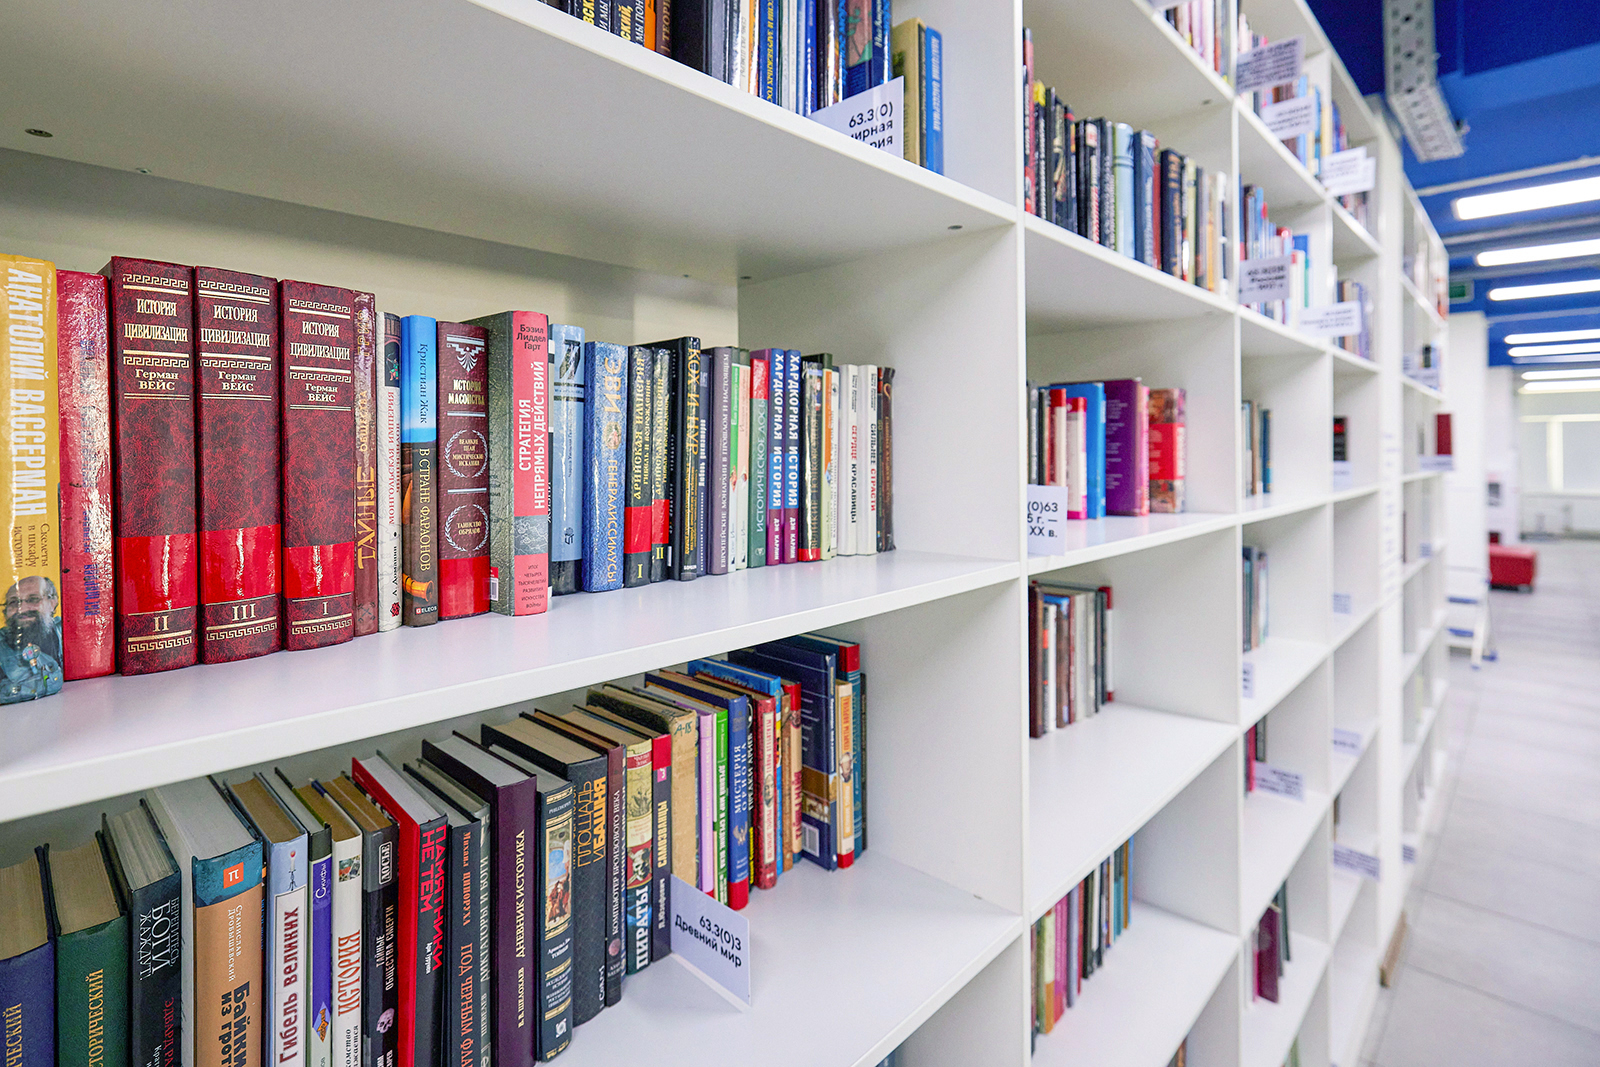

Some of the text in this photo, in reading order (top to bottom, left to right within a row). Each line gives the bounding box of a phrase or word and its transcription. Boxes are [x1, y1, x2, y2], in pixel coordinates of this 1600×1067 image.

[849, 101, 894, 128] 63.3(0)
[136, 298, 178, 317] ИСТОРИЯ
[212, 304, 258, 322] ИСТОРИЯ
[302, 320, 340, 338] ИСТОРИЯ
[520, 323, 544, 335] Бэзил
[124, 323, 189, 343] ЦИВИЛИЗАЦИИ
[200, 327, 270, 348] ЦИВИЛИЗАЦИИ
[290, 343, 351, 362] ЦИВИЛИЗАЦИИ
[517, 332, 547, 343] Лиддел
[524, 341, 541, 352] Гарт
[7, 267, 50, 517] АНАТОЛИЙ ВАССЕРМАН
[135, 368, 179, 382] Герман
[139, 379, 176, 391] ВЕЙС
[218, 370, 256, 382] Герман
[222, 381, 254, 393] ВЕЙС
[305, 383, 338, 394] Герман
[307, 391, 336, 402] ВЕЙС
[418, 342, 430, 424] Кристиан Жак
[447, 392, 486, 405] МАСОНСТВА
[453, 379, 482, 391] ИСТОРИЯ
[604, 356, 622, 414] ЭВИ
[721, 353, 730, 403] НАСТОЯЩЕМ
[386, 391, 396, 444] ИМПЕРИЯ
[685, 347, 700, 456] КОХ-И-НУР
[518, 399, 531, 472] СТРАТЕГИЯ
[530, 361, 546, 509] НЕПРЯМЫХ ДЕЙСТВИЙ
[633, 357, 645, 500] АРИЙСКАЯ ИМПЕРИЯ
[771, 354, 784, 507] ХАРДКОРНАЯ ИСТОРИЯ
[788, 354, 800, 507] ХАРДКОРНАЯ ИСТОРИЯ
[387, 448, 396, 525] МОНГОЛЬСКАЯ
[419, 457, 431, 504] СТРАНЕ
[756, 437, 765, 532] ИСТОРИЧЕСКОЕ
[356, 465, 377, 569] ТАЙНЫЕ
[419, 506, 432, 571] ФАРАОНОВ
[606, 459, 619, 583] ГЕНЕРАЛИССИМУСЫ
[14, 525, 26, 569] истории
[25, 534, 39, 568] шкафу
[39, 523, 51, 568] Скелеты
[153, 616, 170, 632] II
[232, 603, 256, 622] III
[322, 602, 329, 616] I
[718, 764, 726, 794] ДРЕВНИЙ
[733, 745, 742, 814] МИСТЕРИЯ
[576, 780, 593, 868] ПЛОЩАДЬ
[593, 776, 607, 847] БАШНЯ
[718, 796, 726, 811] МИР
[657, 800, 669, 868] САМОЗВАНЦЫ
[314, 863, 327, 899] Скифы
[380, 843, 391, 881] ДОСЬЕ
[420, 831, 434, 913] НЕ ТЕМ
[479, 856, 489, 888] БОГИ
[612, 790, 621, 936] КОМПЬЮТЕР БРОНЗОВОГО ВЕКА
[718, 847, 726, 869] ВЕКА
[431, 823, 447, 972] ПАМЯТНИКИ
[515, 829, 526, 1010] ШЕЛОХАЕВ ДНЕВНИК ИСТОРИКА
[139, 913, 153, 982] ЖАЖДУТ!
[152, 901, 171, 975] БОГИ
[384, 903, 396, 990] ОБЩЕСТВА СМЕРТИ
[458, 831, 473, 1037] Михаил ЦИПОРУХА ПОД ЧЕРНЫМ
[479, 904, 489, 982] ДИКТАТОРЫ
[634, 884, 650, 969] ПИРАТЫ
[675, 914, 742, 968] Древний мир
[699, 915, 742, 952] 63.3(0)3
[337, 930, 361, 1017] ИСТОРИЯ
[373, 935, 385, 968] ТАЙНЫЕ
[221, 990, 233, 1017] из
[278, 906, 300, 1064] Гибель великих
[163, 997, 175, 1045] ЭДВАРД
